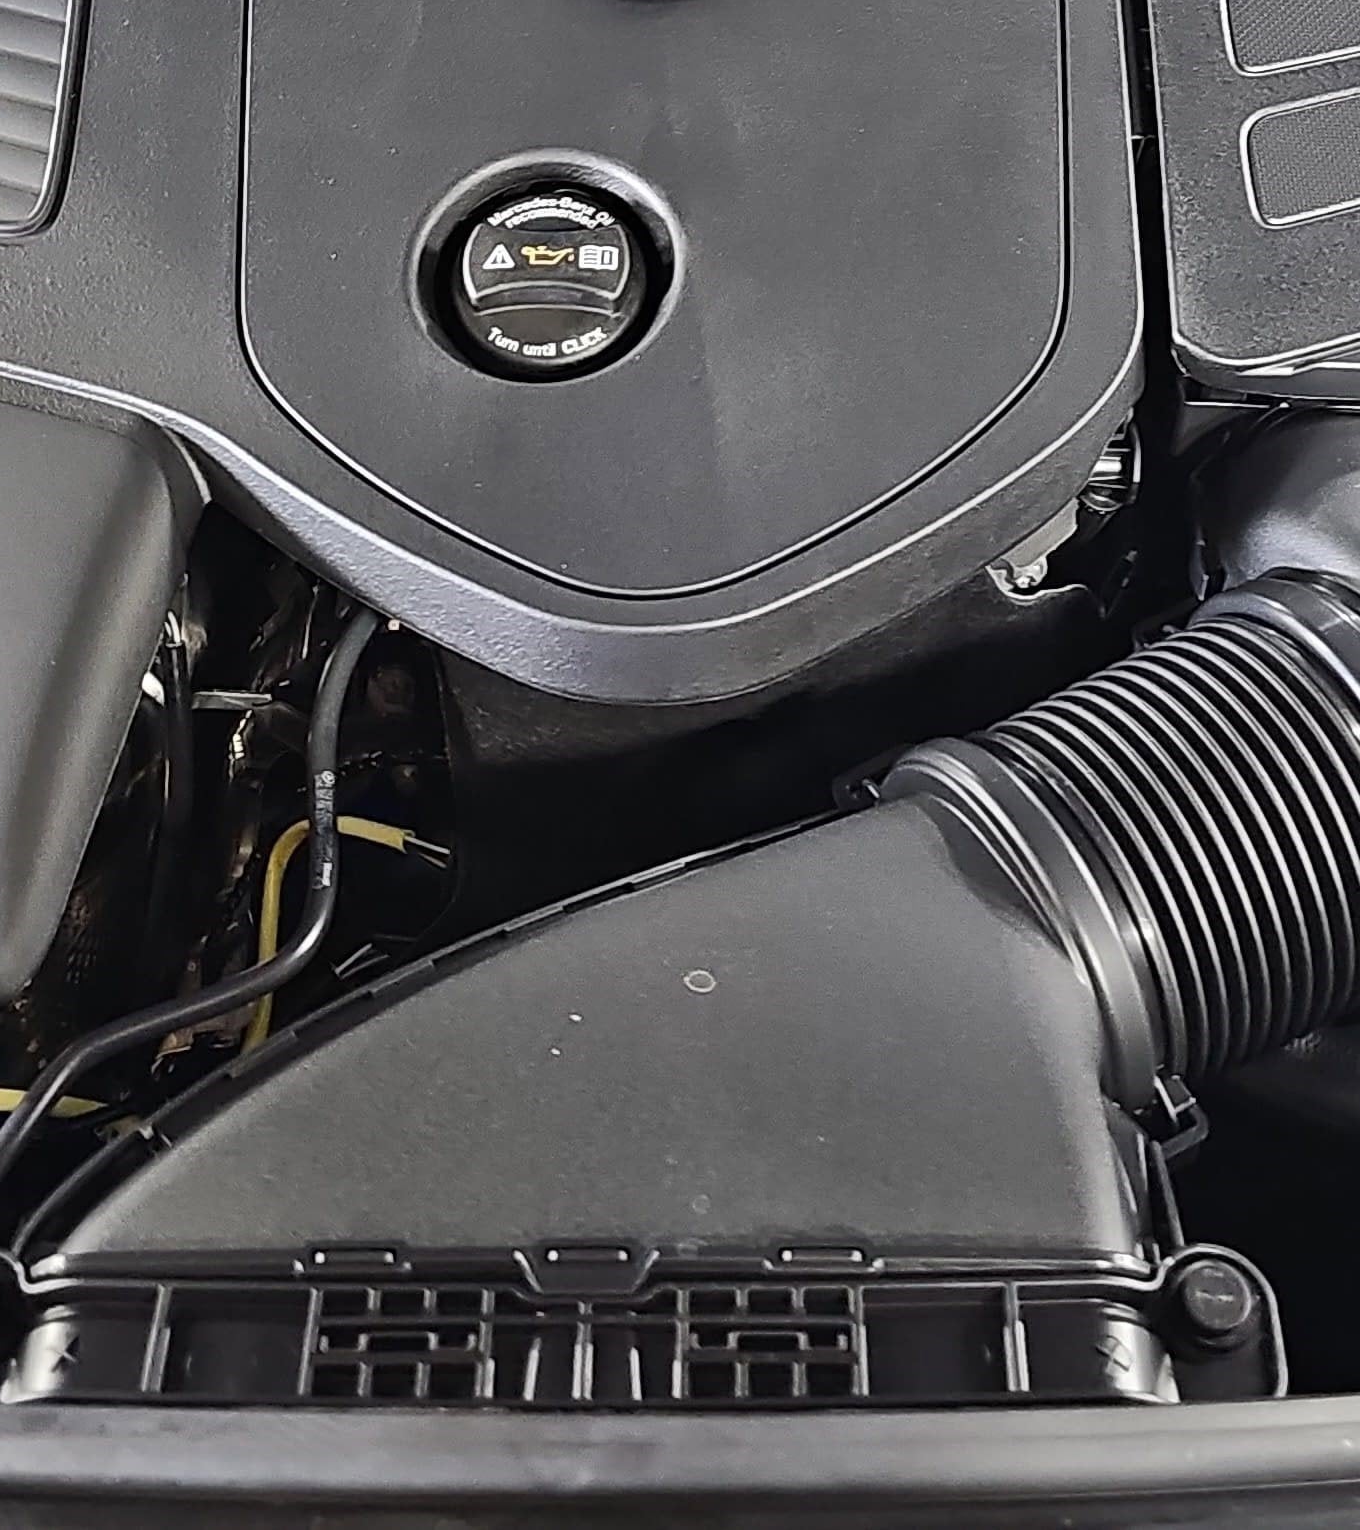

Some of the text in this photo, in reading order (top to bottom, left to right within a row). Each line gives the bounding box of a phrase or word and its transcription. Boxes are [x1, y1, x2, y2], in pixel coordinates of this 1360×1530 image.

[487, 197, 596, 227] Mercedes-Benz
[504, 207, 599, 229] recommended
[487, 326, 608, 356] Turn until CLICK
